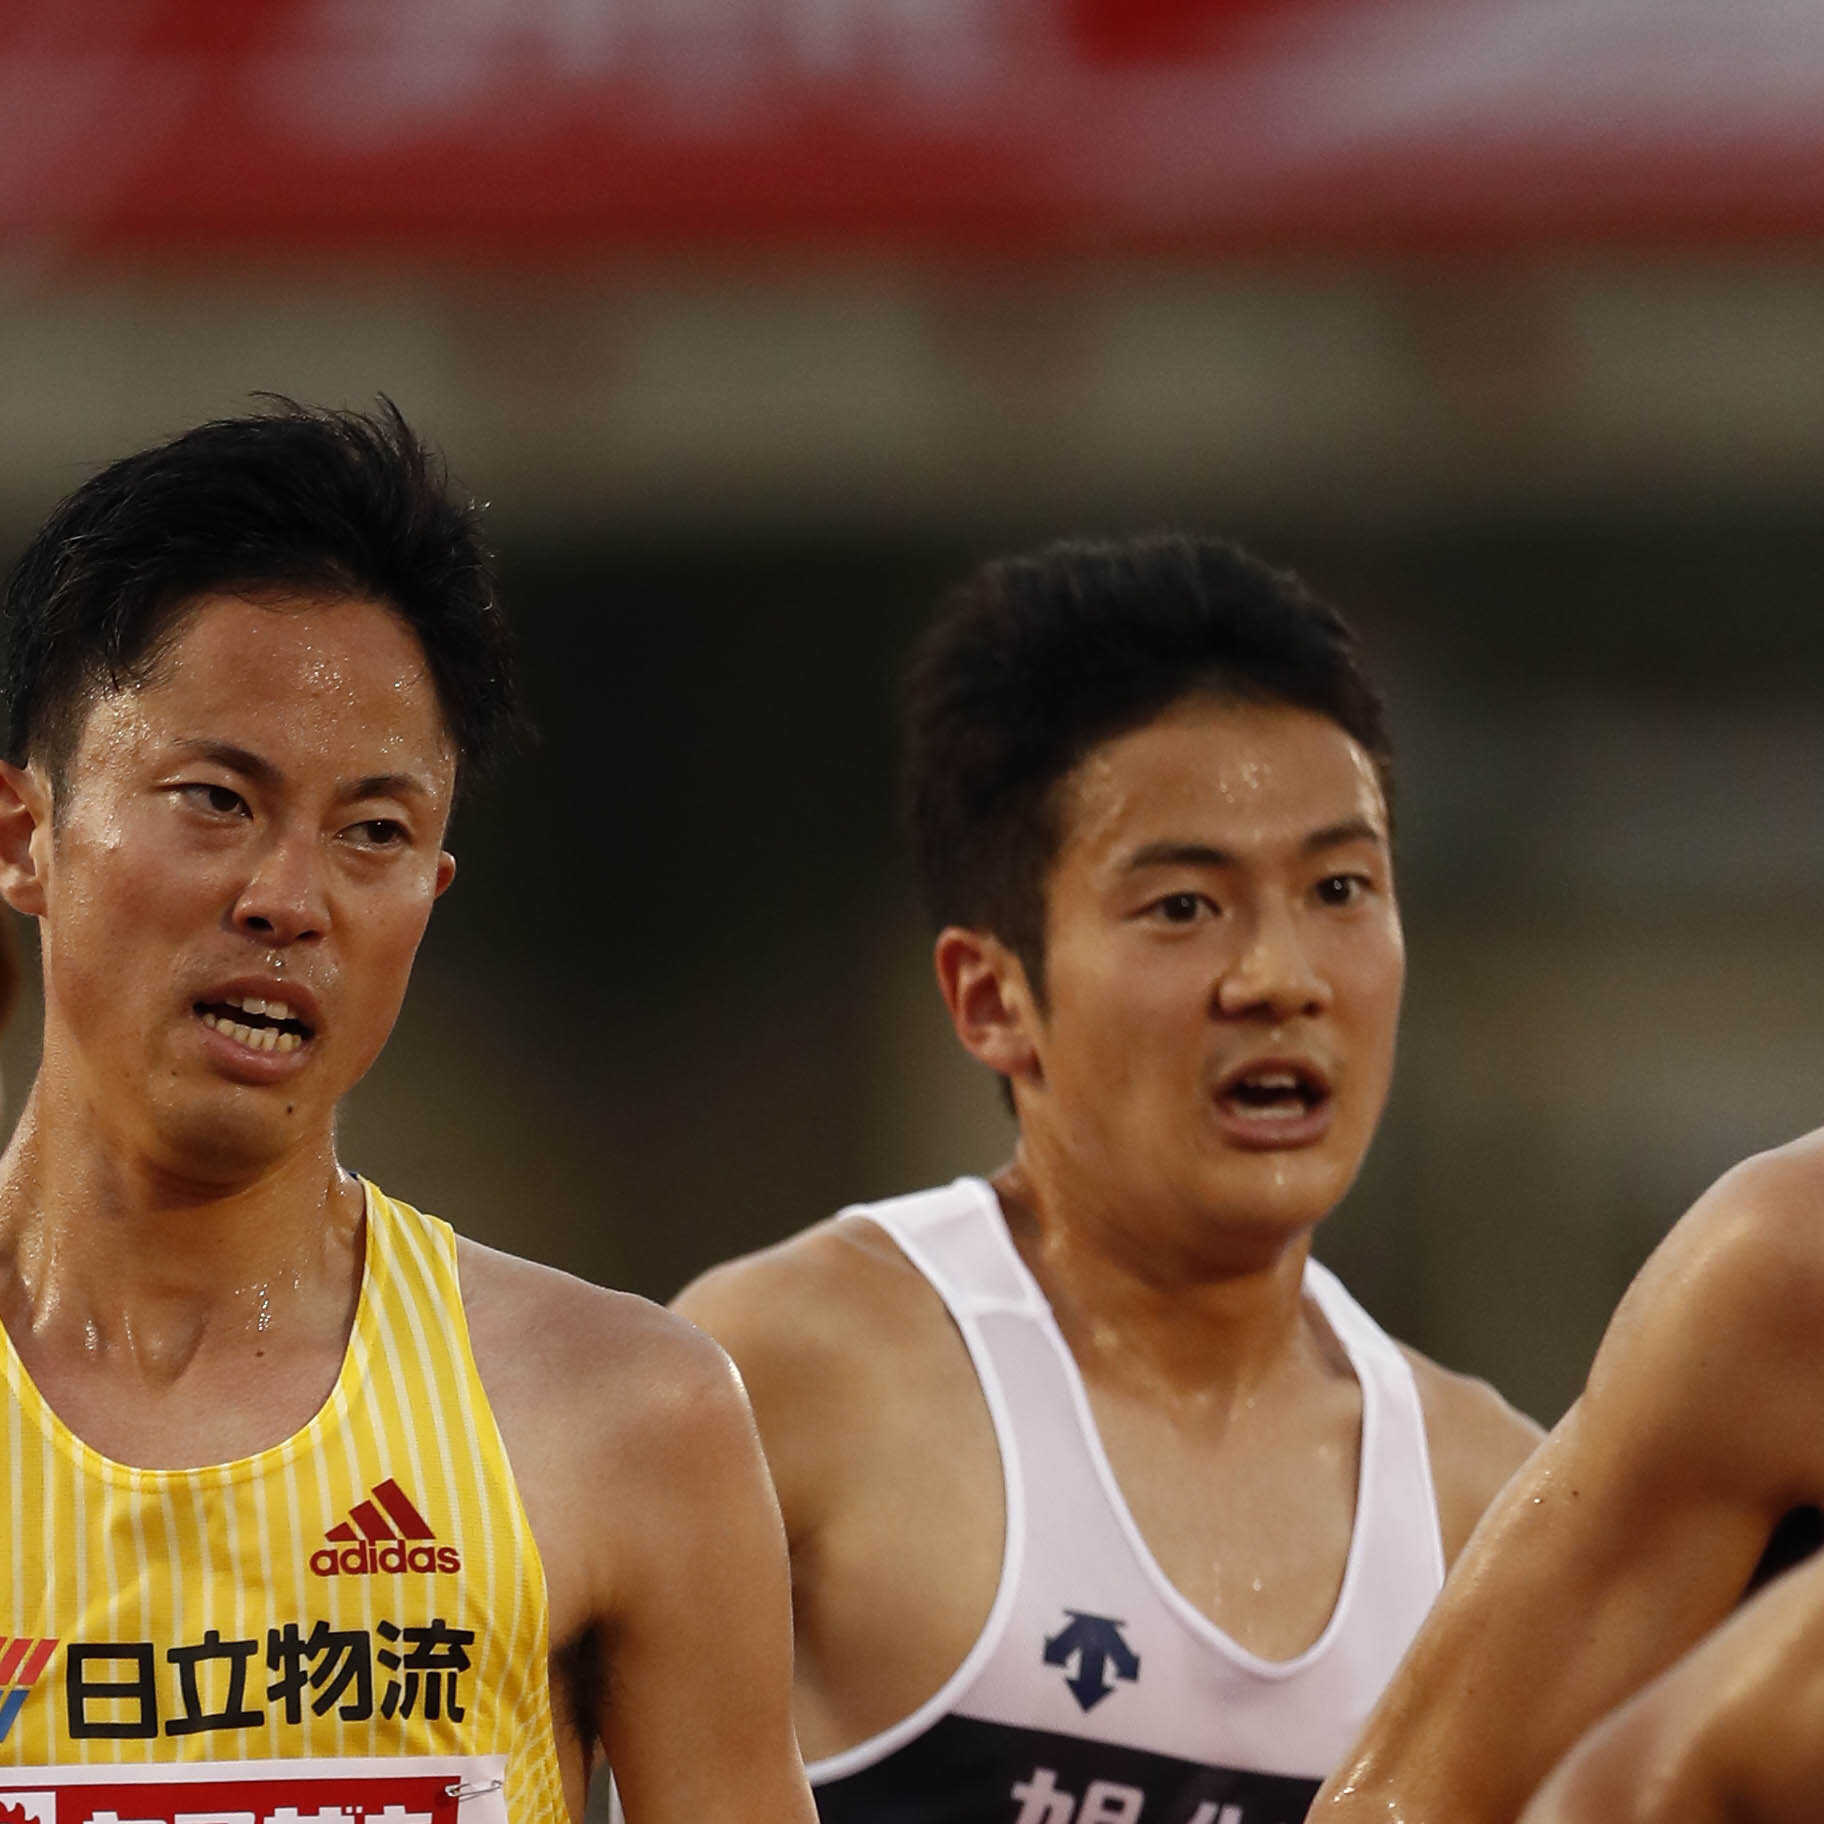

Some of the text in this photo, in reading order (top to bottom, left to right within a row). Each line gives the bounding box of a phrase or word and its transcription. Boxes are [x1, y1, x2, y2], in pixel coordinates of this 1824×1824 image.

[310, 1538, 461, 1577] adidas
[65, 1619, 475, 1740] 日立物流
